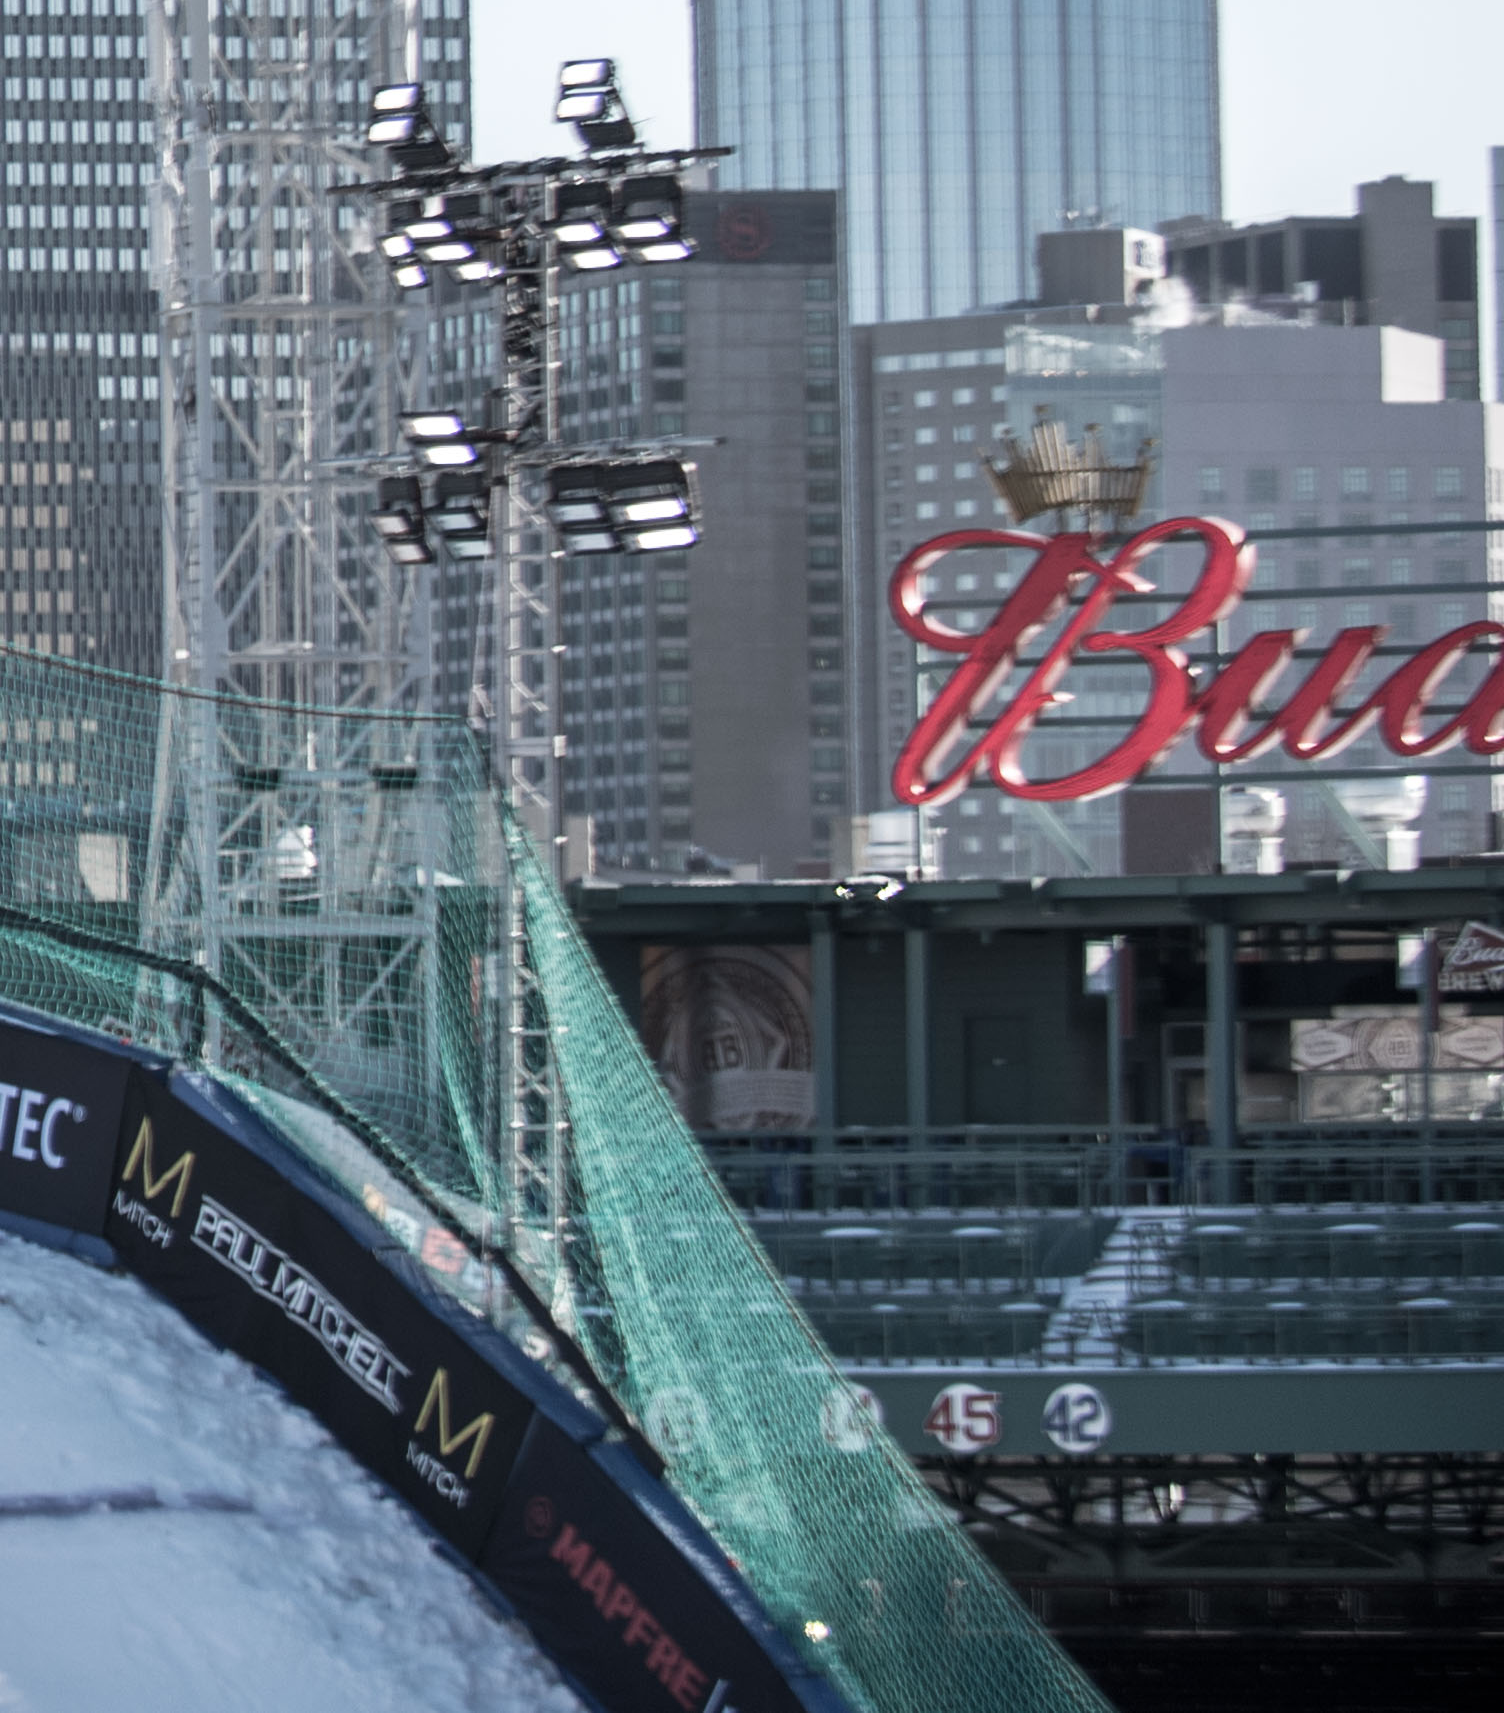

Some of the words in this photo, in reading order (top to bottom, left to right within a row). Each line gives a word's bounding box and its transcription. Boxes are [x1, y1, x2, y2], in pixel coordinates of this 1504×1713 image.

[112, 1190, 177, 1251] MITCH
[194, 1202, 273, 1287] PAUL
[923, 1391, 1002, 1446] 45
[1041, 1392, 1106, 1445] 42
[404, 1438, 472, 1510] MITCH
[549, 1522, 711, 1713] MAPFRE
